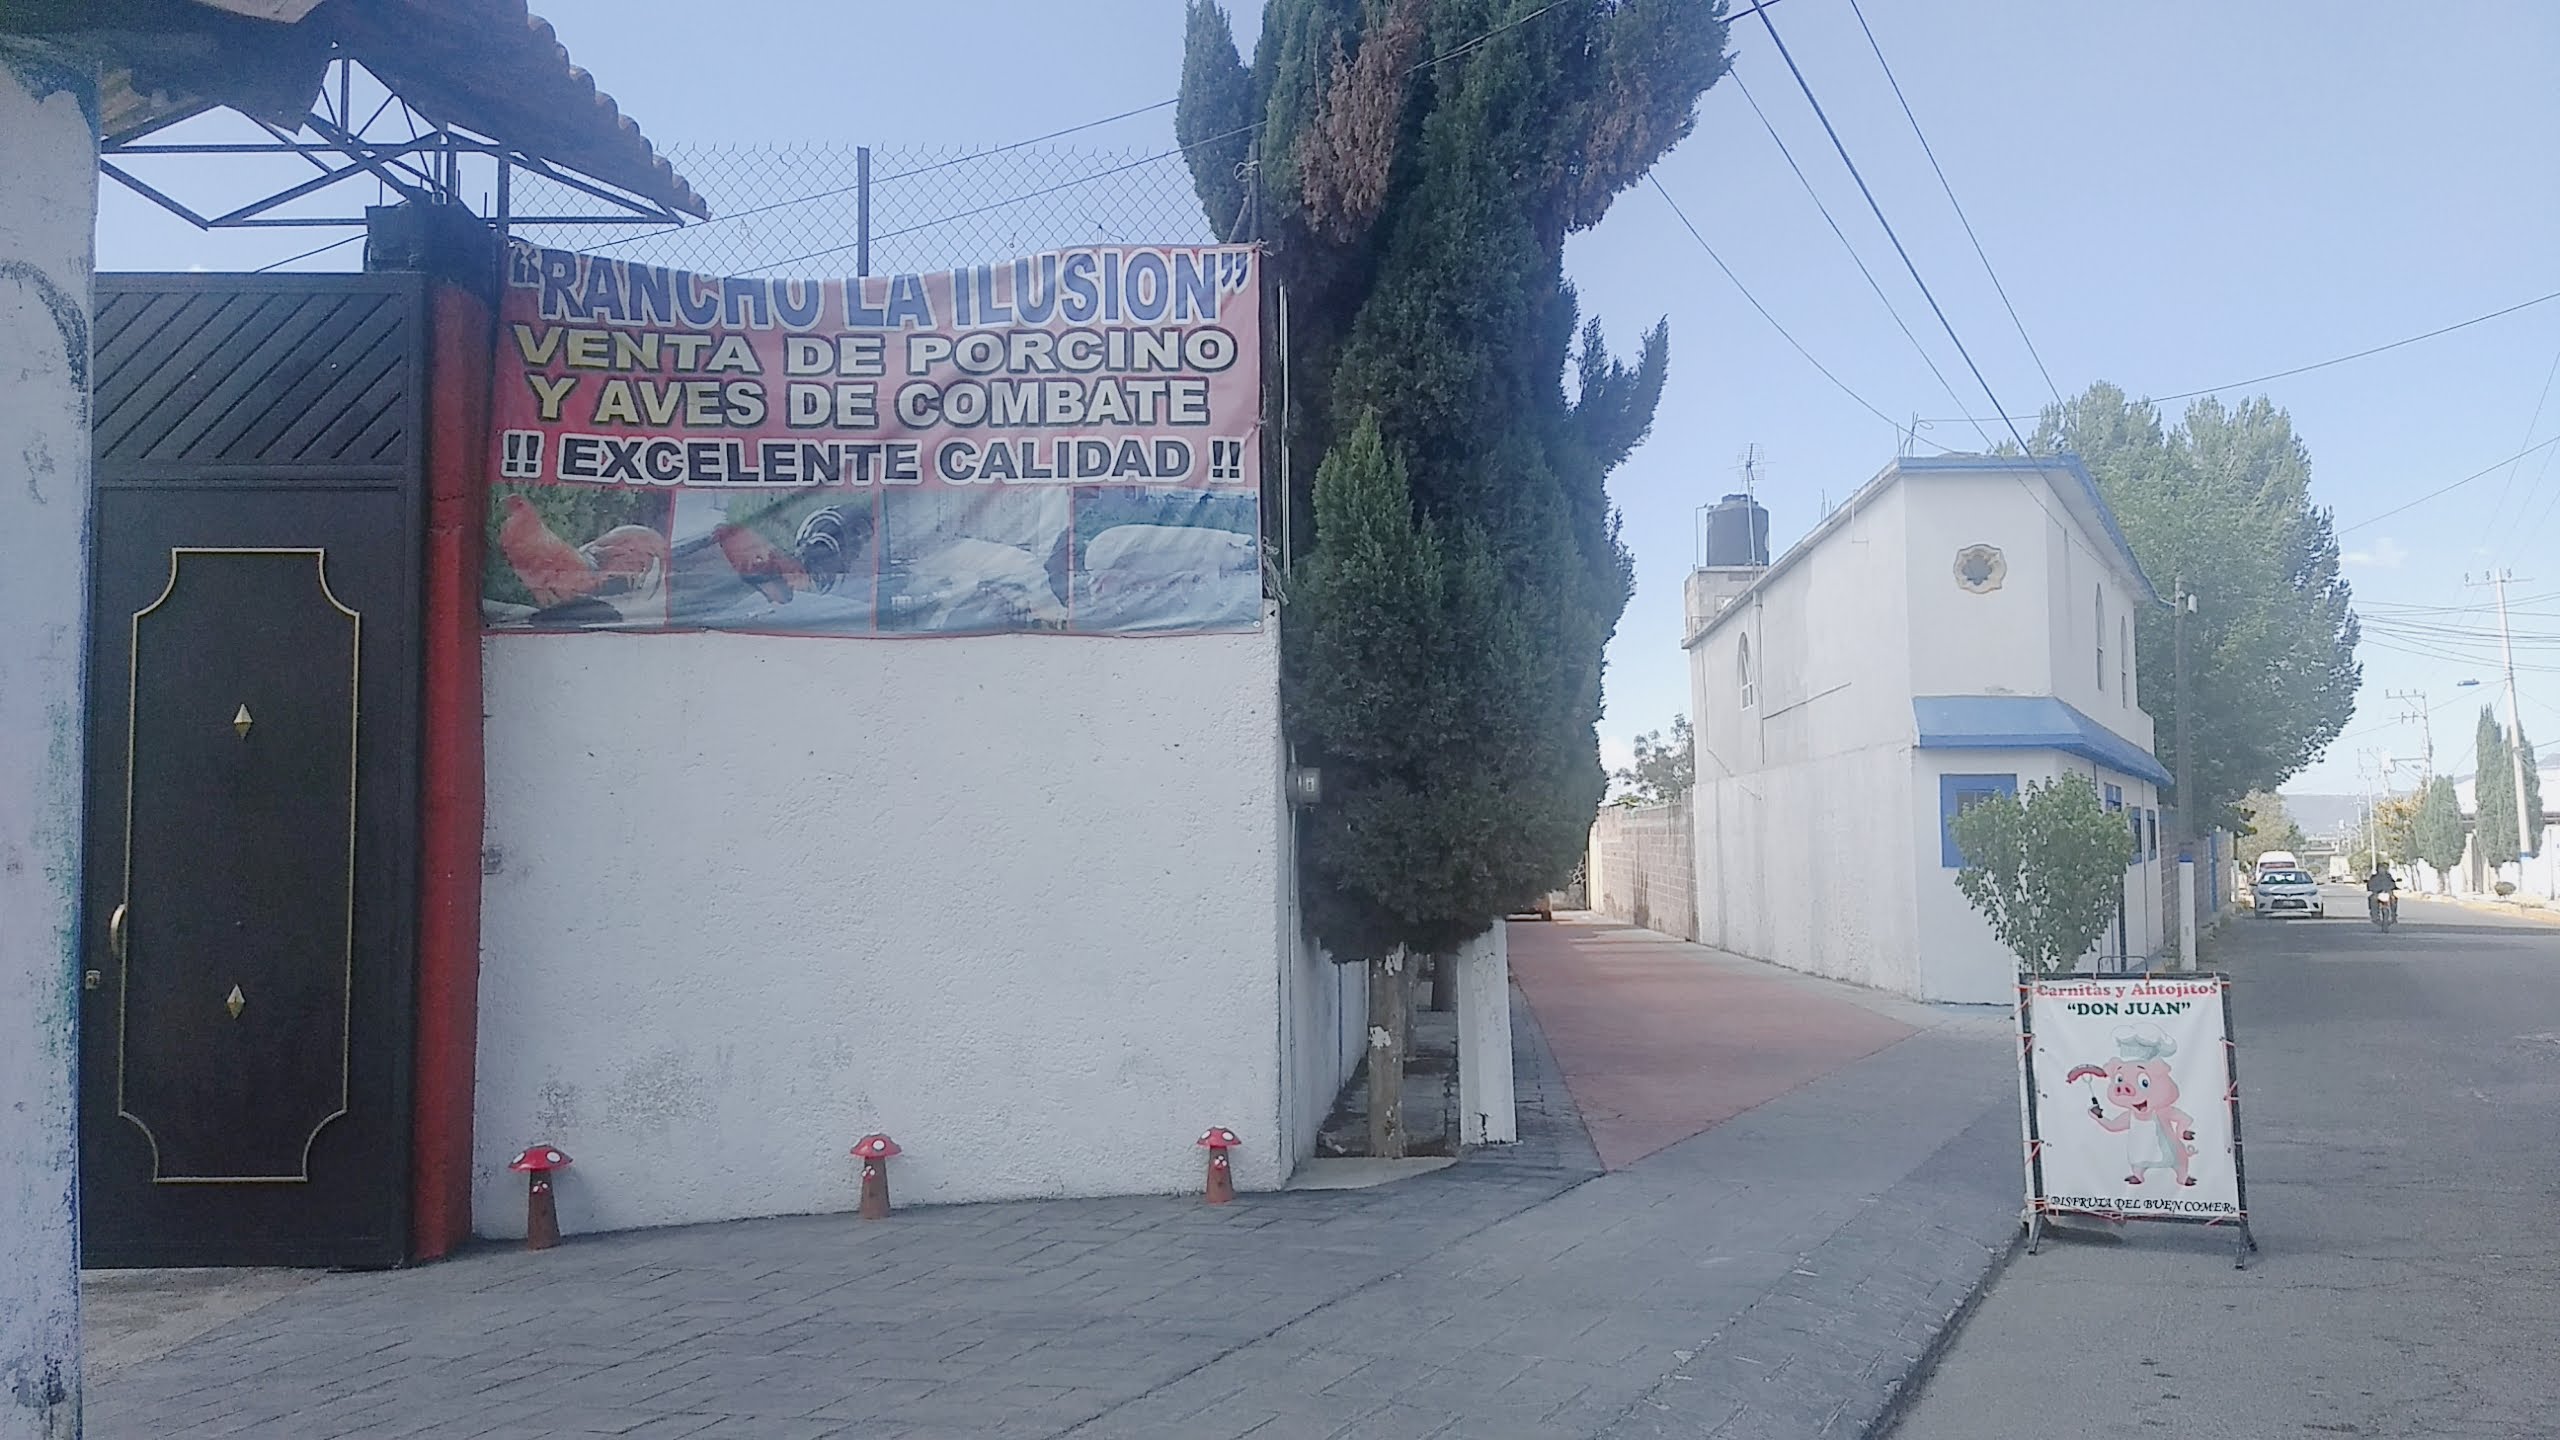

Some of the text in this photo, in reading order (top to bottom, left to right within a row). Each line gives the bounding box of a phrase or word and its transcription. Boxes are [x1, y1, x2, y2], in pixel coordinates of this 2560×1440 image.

[844, 274, 937, 330] LA
[513, 324, 1237, 376] VENTA DE PORCINO
[526, 373, 1209, 428] Y AVES DE COMBATE
[559, 433, 922, 486] EXCELENTE
[935, 435, 1195, 484] CALIDAD
[2037, 982, 2218, 998] Carnitas y Antojitos
[2050, 1195, 2112, 1209] DISFRUTA
[2114, 1198, 2141, 1210] DEL
[2143, 1199, 2184, 1213] BUEN
